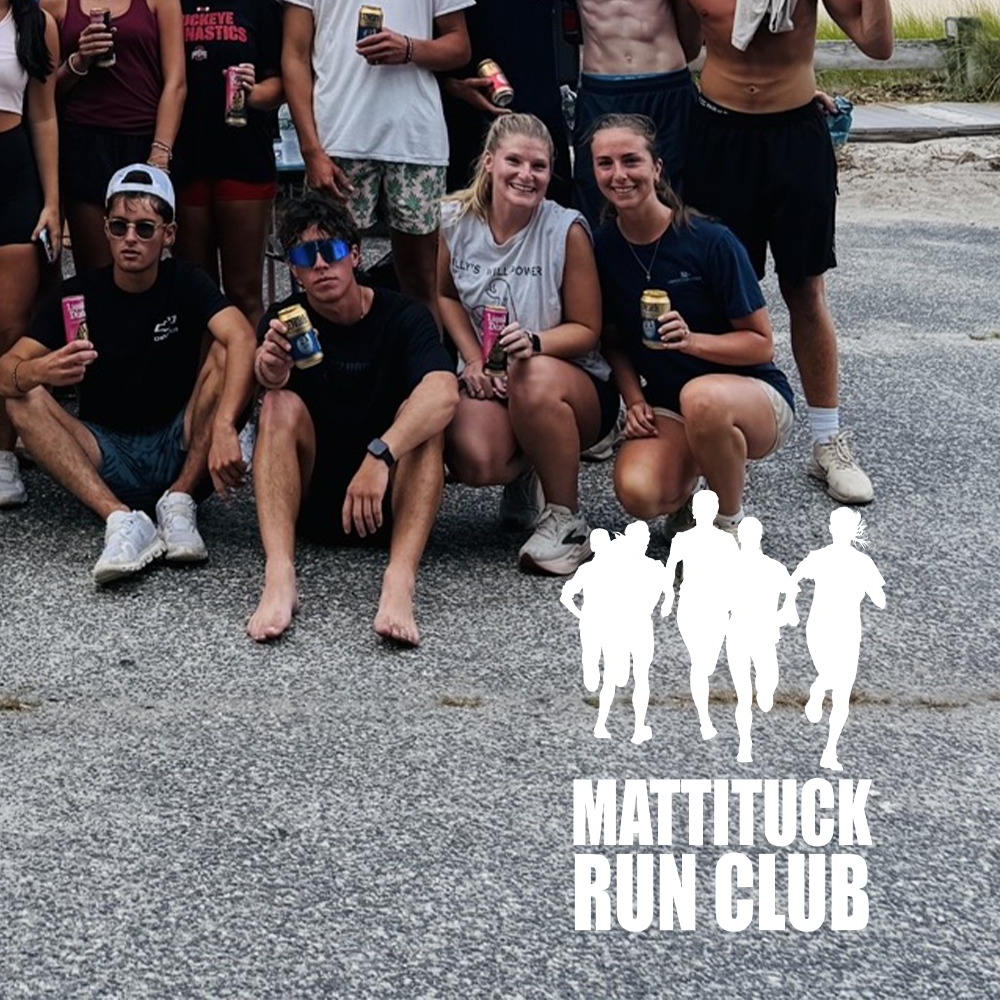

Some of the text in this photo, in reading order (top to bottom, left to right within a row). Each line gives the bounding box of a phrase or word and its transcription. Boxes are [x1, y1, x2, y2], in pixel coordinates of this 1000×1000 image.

[183, 11, 234, 26] UCKEYE
[184, 25, 247, 43] NASTICS
[452, 257, 482, 274] ILLY'S
